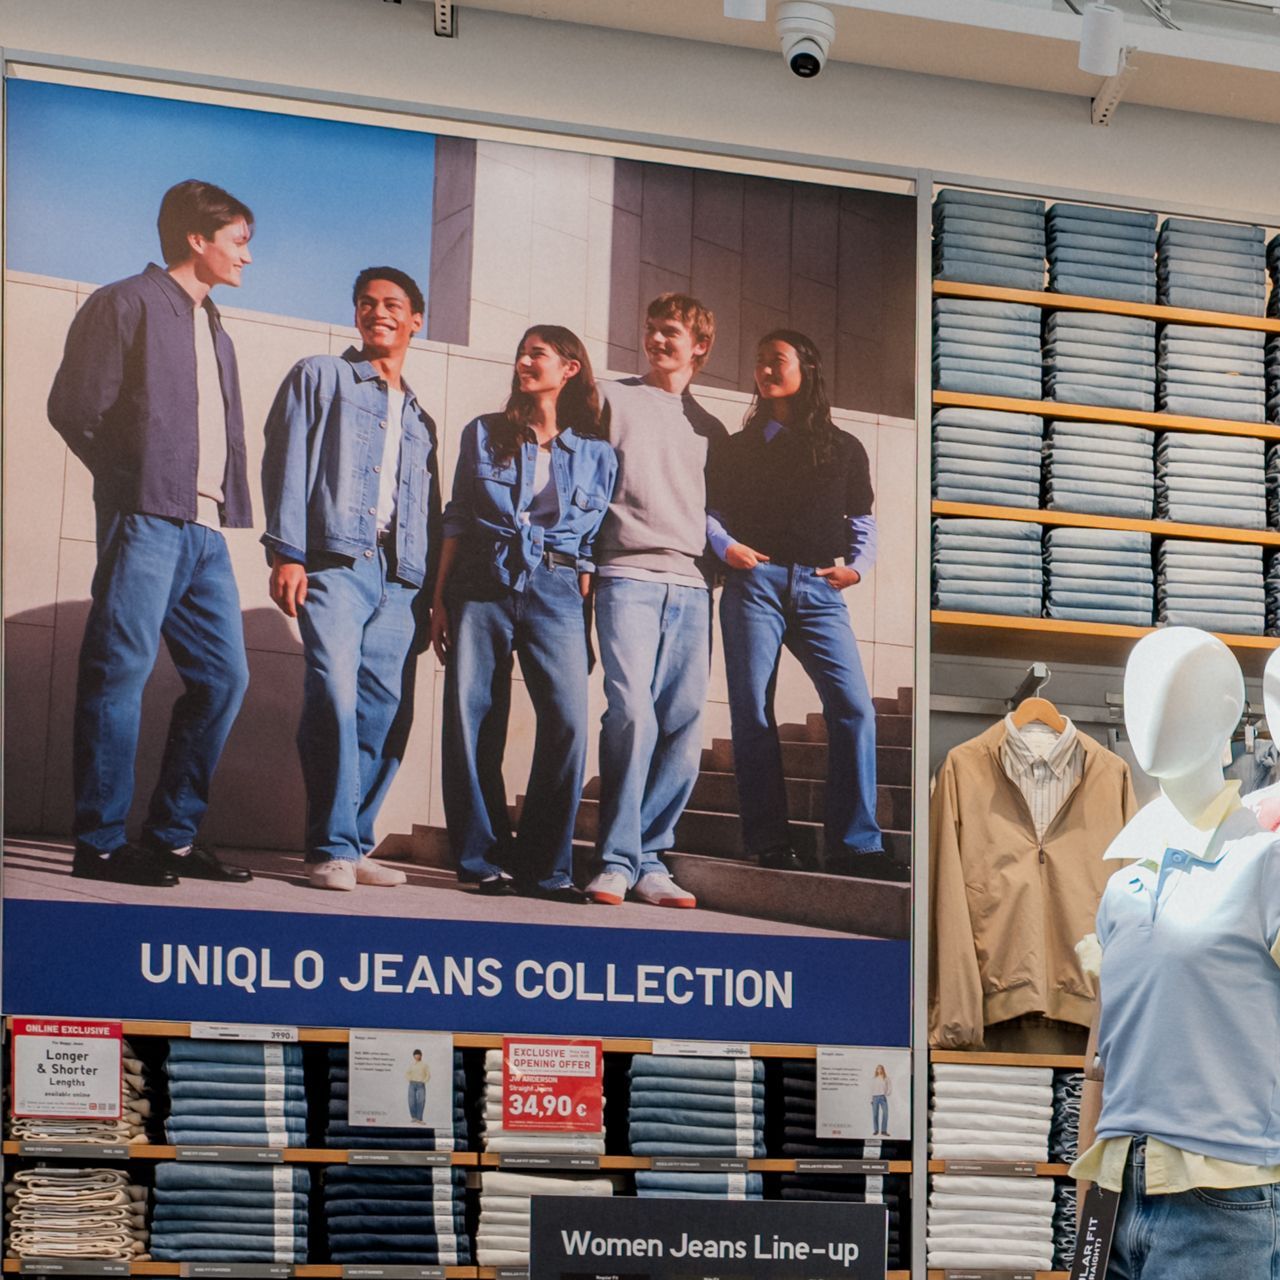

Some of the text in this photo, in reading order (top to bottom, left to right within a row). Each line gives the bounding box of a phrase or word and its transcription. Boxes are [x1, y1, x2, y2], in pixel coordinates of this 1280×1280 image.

[140, 943, 793, 1009] UNIQLO JEANS COLLECTION
[25, 1024, 110, 1035] ONLINE EXCLUSIVE
[46, 1049, 89, 1063] Longer
[514, 1048, 565, 1057] EXCLUSIVE
[37, 1063, 98, 1075] & Shorter
[514, 1059, 591, 1069] OPENING OFFER
[49, 1077, 85, 1088] Lengths
[509, 1094, 587, 1118] 34,90 €
[1086, 1217, 1098, 1242] FIT
[561, 1230, 859, 1267] Women Jeans Line-up
